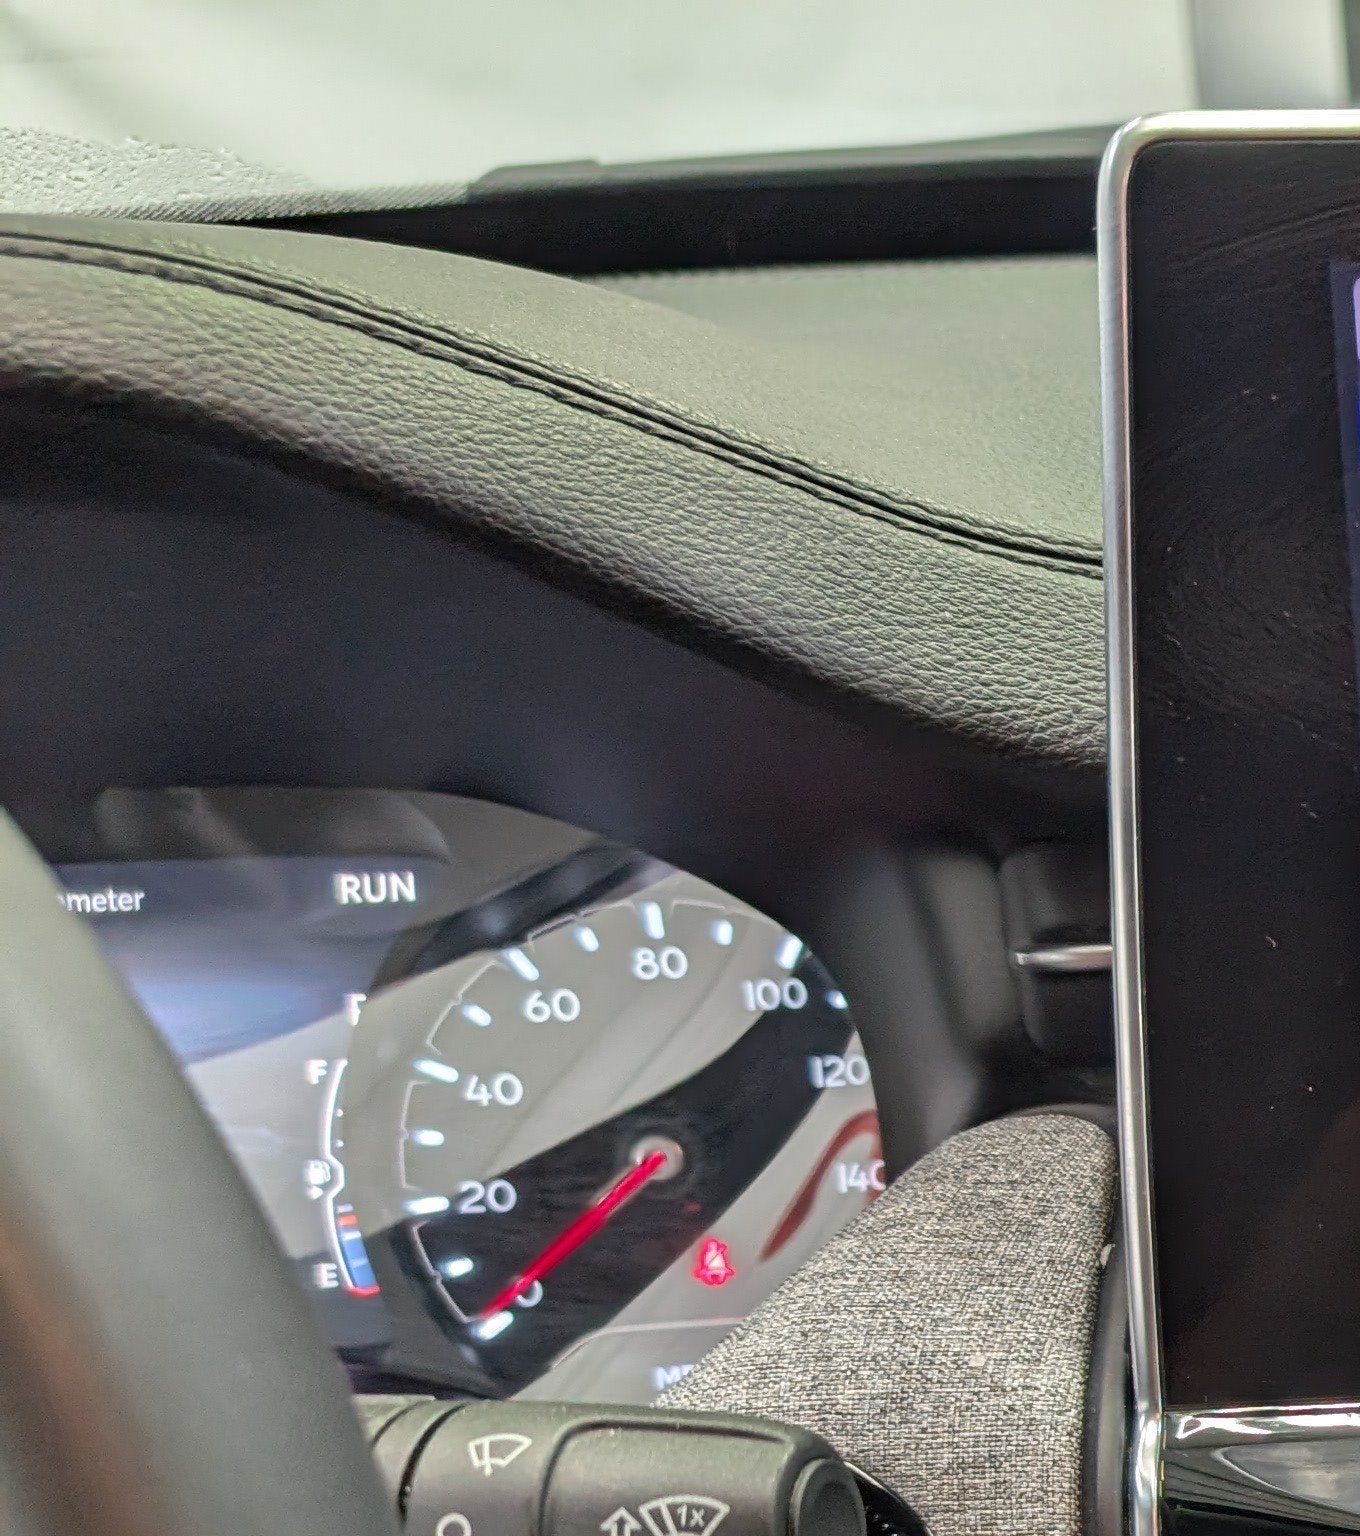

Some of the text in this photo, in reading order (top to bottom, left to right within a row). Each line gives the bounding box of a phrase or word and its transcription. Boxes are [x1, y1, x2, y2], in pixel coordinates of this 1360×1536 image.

[60, 887, 146, 914] meter
[335, 872, 417, 905] RUN
[630, 946, 690, 980] 80
[523, 987, 582, 1024] 60
[743, 978, 809, 1013] 100
[306, 1059, 328, 1085] F
[464, 1071, 525, 1107] 40
[811, 1054, 869, 1089] 120
[457, 1179, 518, 1214] 20
